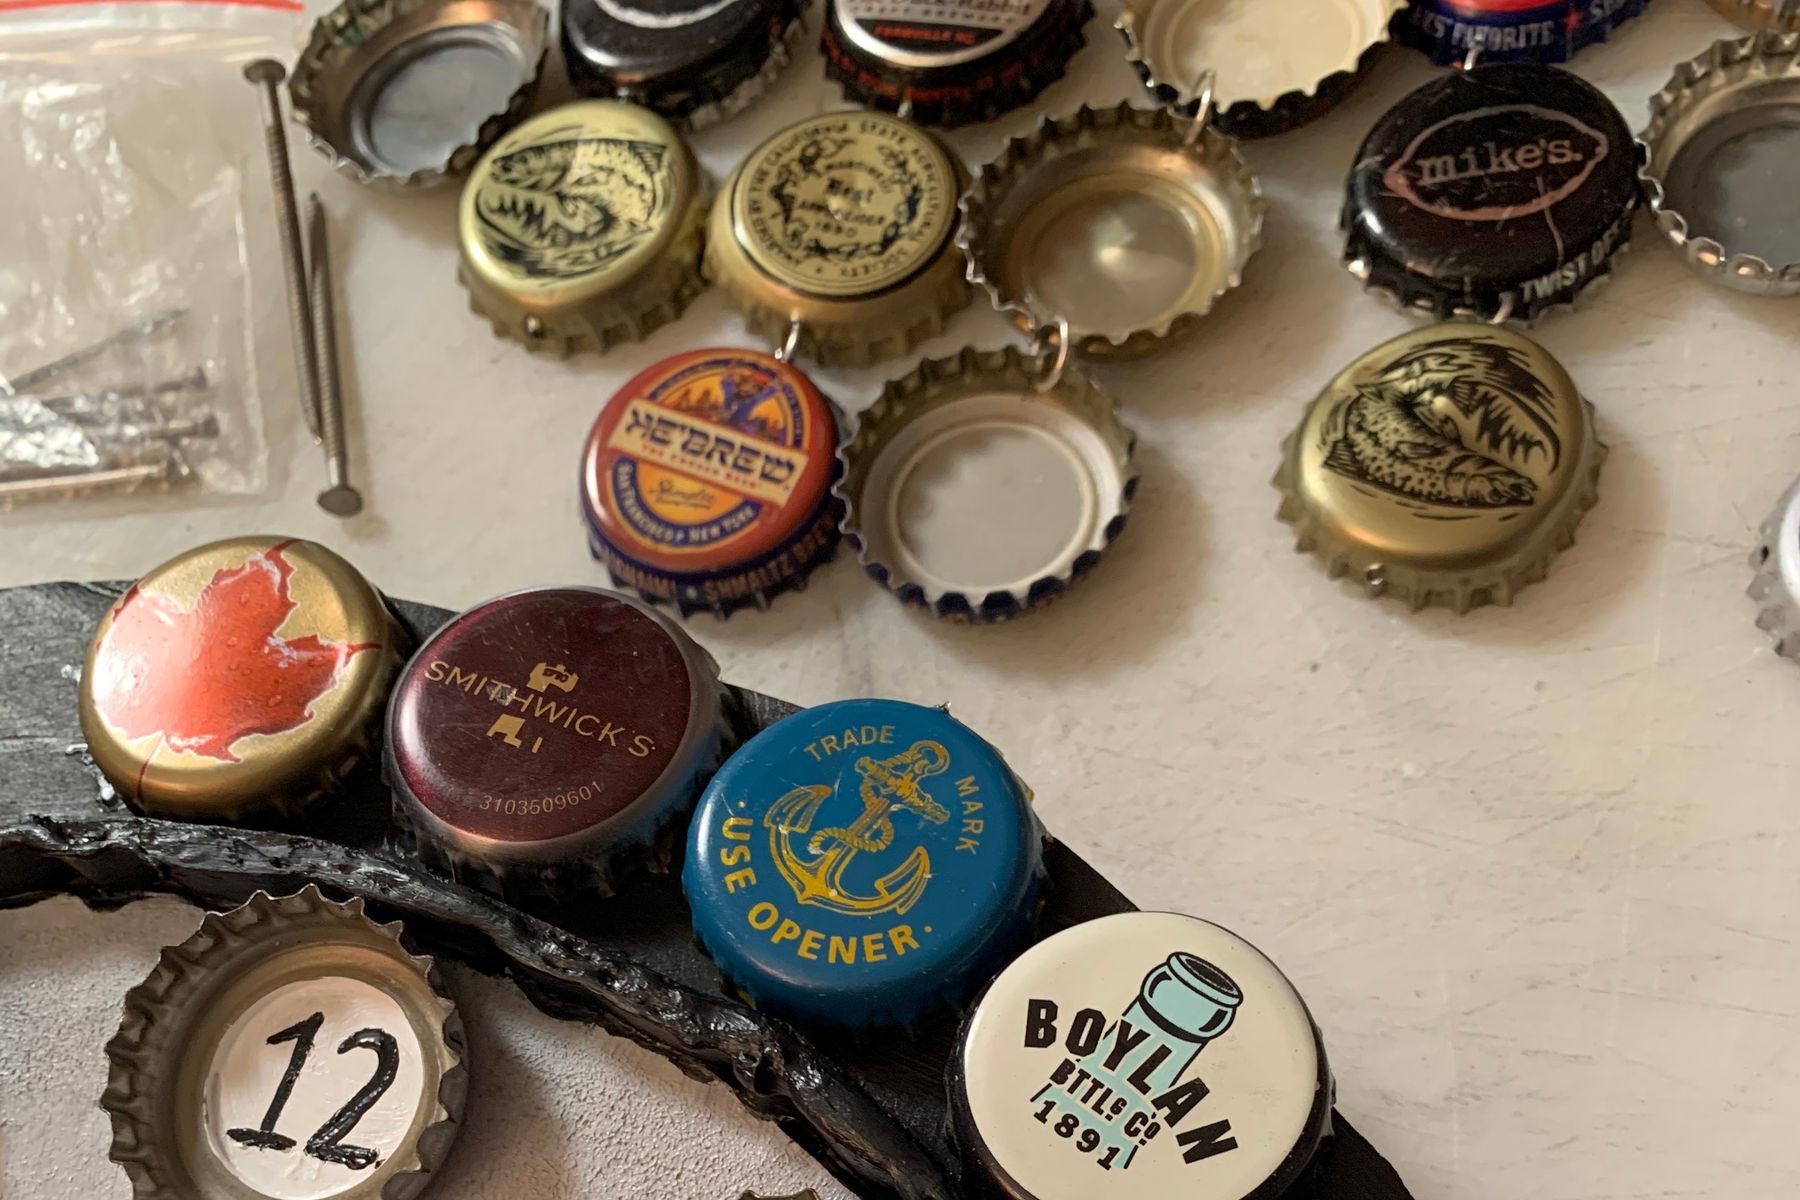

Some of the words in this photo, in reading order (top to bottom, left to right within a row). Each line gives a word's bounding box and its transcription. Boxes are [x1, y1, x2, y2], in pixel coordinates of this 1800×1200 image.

[860, 121, 907, 144] STATE
[1521, 253, 1588, 303] TWIST
[804, 725, 896, 762] TRADE
[954, 775, 984, 856] MARK
[226, 1011, 400, 1170] 12
[1023, 998, 1239, 1165] BOYLAN
[1033, 1099, 1121, 1171] 1891
